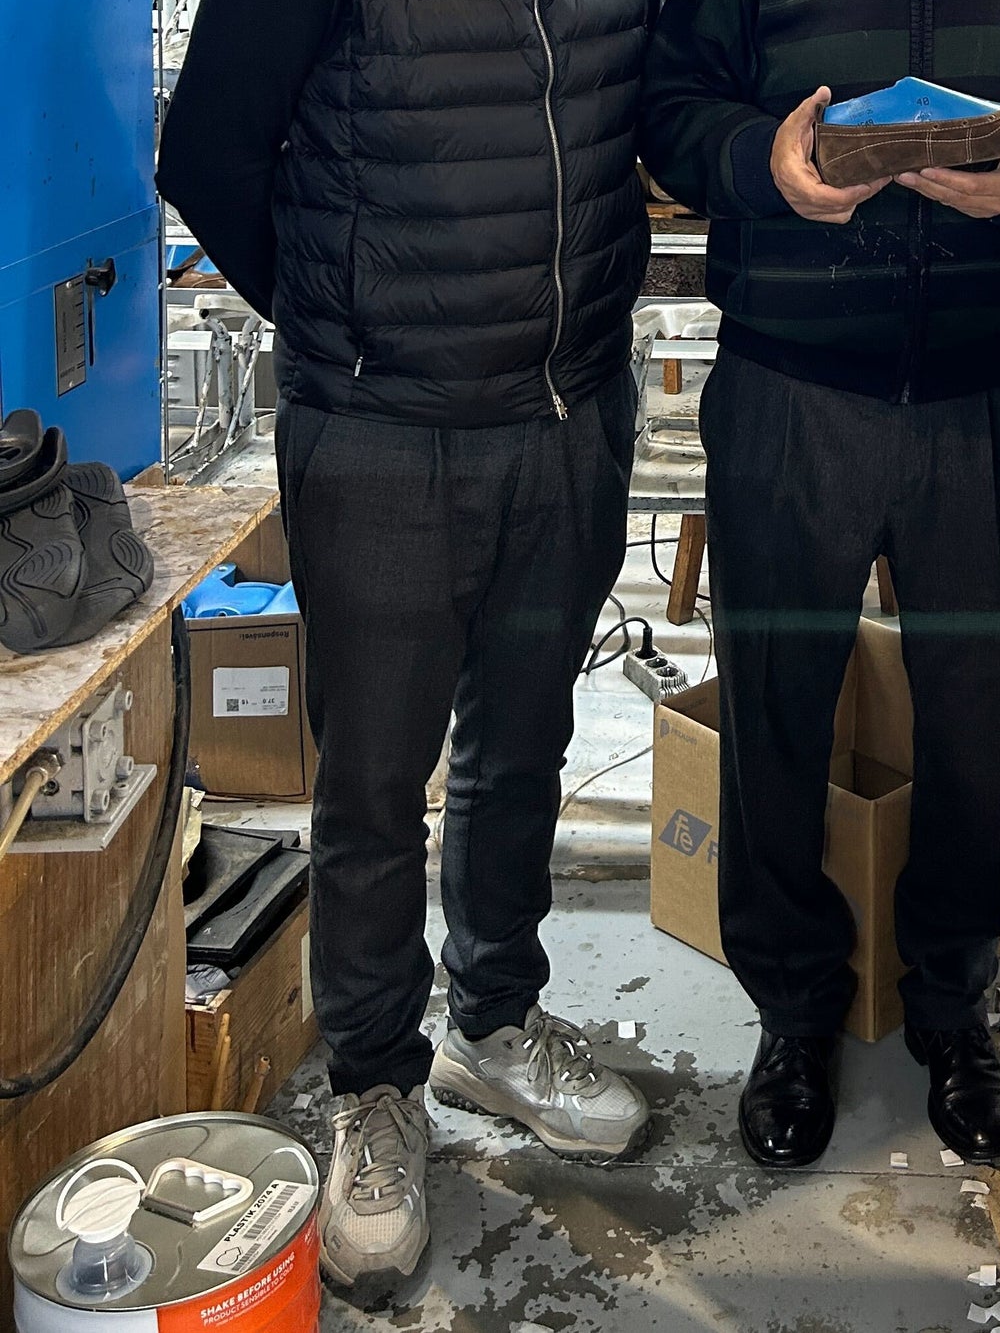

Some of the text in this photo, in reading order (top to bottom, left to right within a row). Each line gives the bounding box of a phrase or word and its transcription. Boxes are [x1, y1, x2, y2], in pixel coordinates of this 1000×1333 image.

[707, 839, 719, 864] F
[223, 1209, 257, 1242] PLASTIK
[255, 1190, 273, 1209] 2074
[271, 1183, 280, 1191] A
[200, 1296, 235, 1319] SHAKE
[237, 1272, 272, 1302] BEFORE
[272, 1251, 296, 1277] USING
[203, 1262, 294, 1327] PRODUCT SENSIBLE TO COLD
